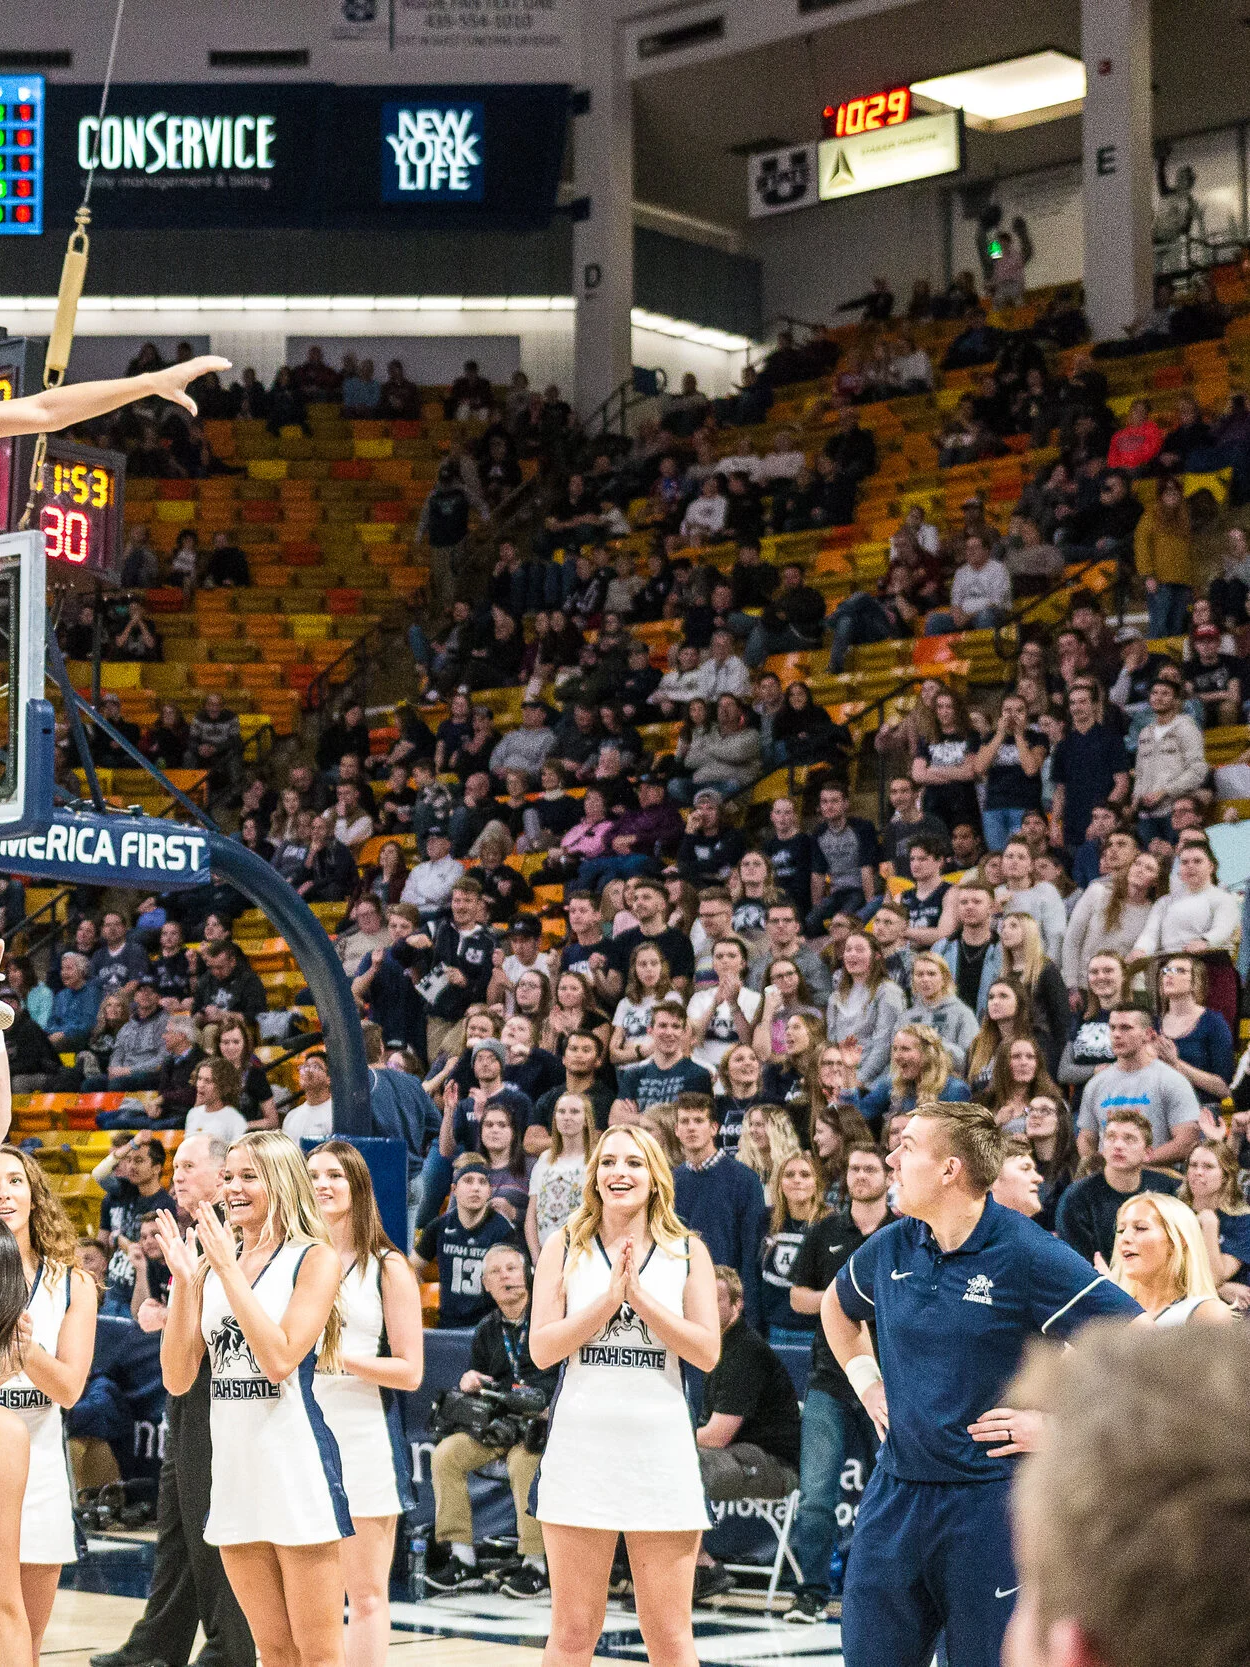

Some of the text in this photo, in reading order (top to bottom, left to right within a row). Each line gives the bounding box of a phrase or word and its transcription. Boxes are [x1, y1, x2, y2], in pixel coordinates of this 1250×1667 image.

[397, 109, 473, 138] NEW
[386, 134, 480, 167] YORK
[1096, 146, 1116, 176] E
[399, 162, 471, 191] LIFE
[584, 264, 601, 289] D
[41, 505, 89, 562] 30
[121, 832, 206, 871] FIRST
[442, 1243, 468, 1256] UTAH
[450, 1256, 482, 1296] 13
[579, 1345, 666, 1371] UTAH STATE
[212, 1377, 280, 1400] TAH STATE
